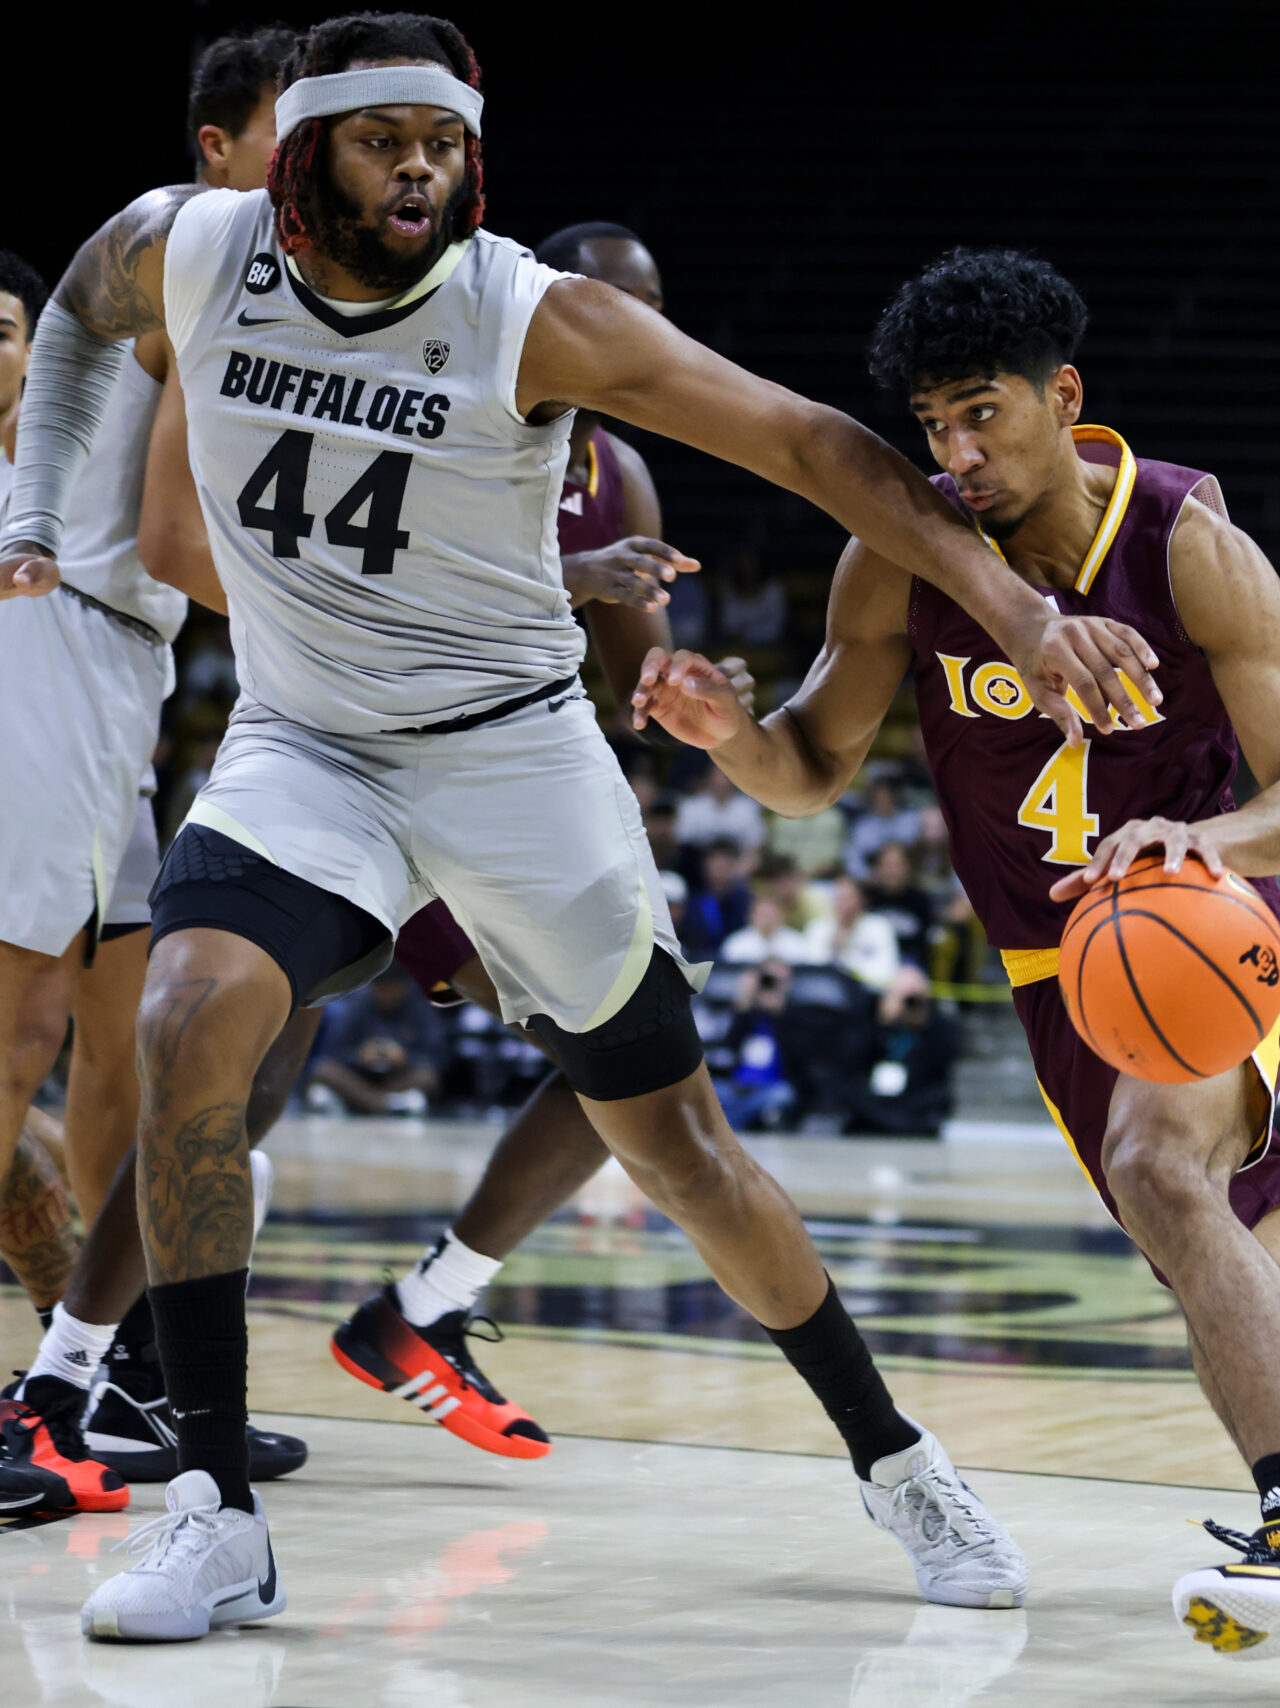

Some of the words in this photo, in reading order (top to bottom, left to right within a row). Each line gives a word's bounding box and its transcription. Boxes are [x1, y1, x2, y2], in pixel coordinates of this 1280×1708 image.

[246, 261, 275, 287] BH
[219, 350, 451, 440] BUFFALOES
[427, 354, 441, 369] 12
[236, 428, 414, 575] 44
[1017, 738, 1100, 867] 4
